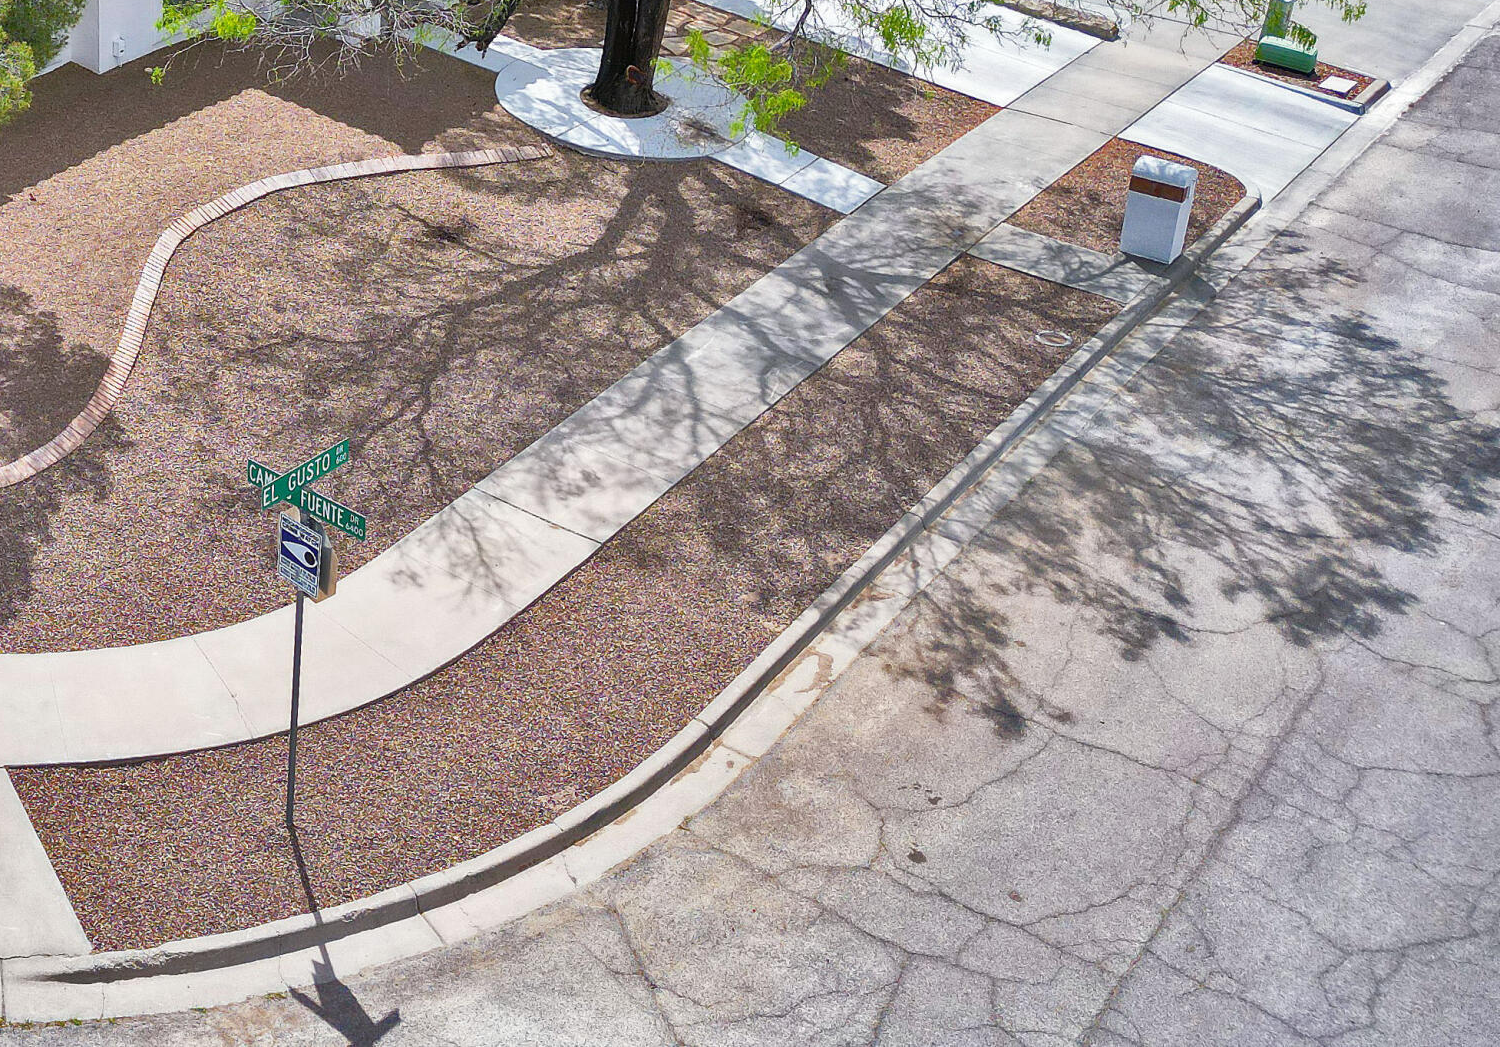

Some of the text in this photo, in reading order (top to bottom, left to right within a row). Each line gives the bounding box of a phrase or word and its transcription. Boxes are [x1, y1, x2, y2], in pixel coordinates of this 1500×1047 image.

[263, 484, 279, 507] EL
[288, 453, 330, 491] GUSTO
[301, 489, 344, 528] FUENTE
[350, 514, 359, 525] DR
